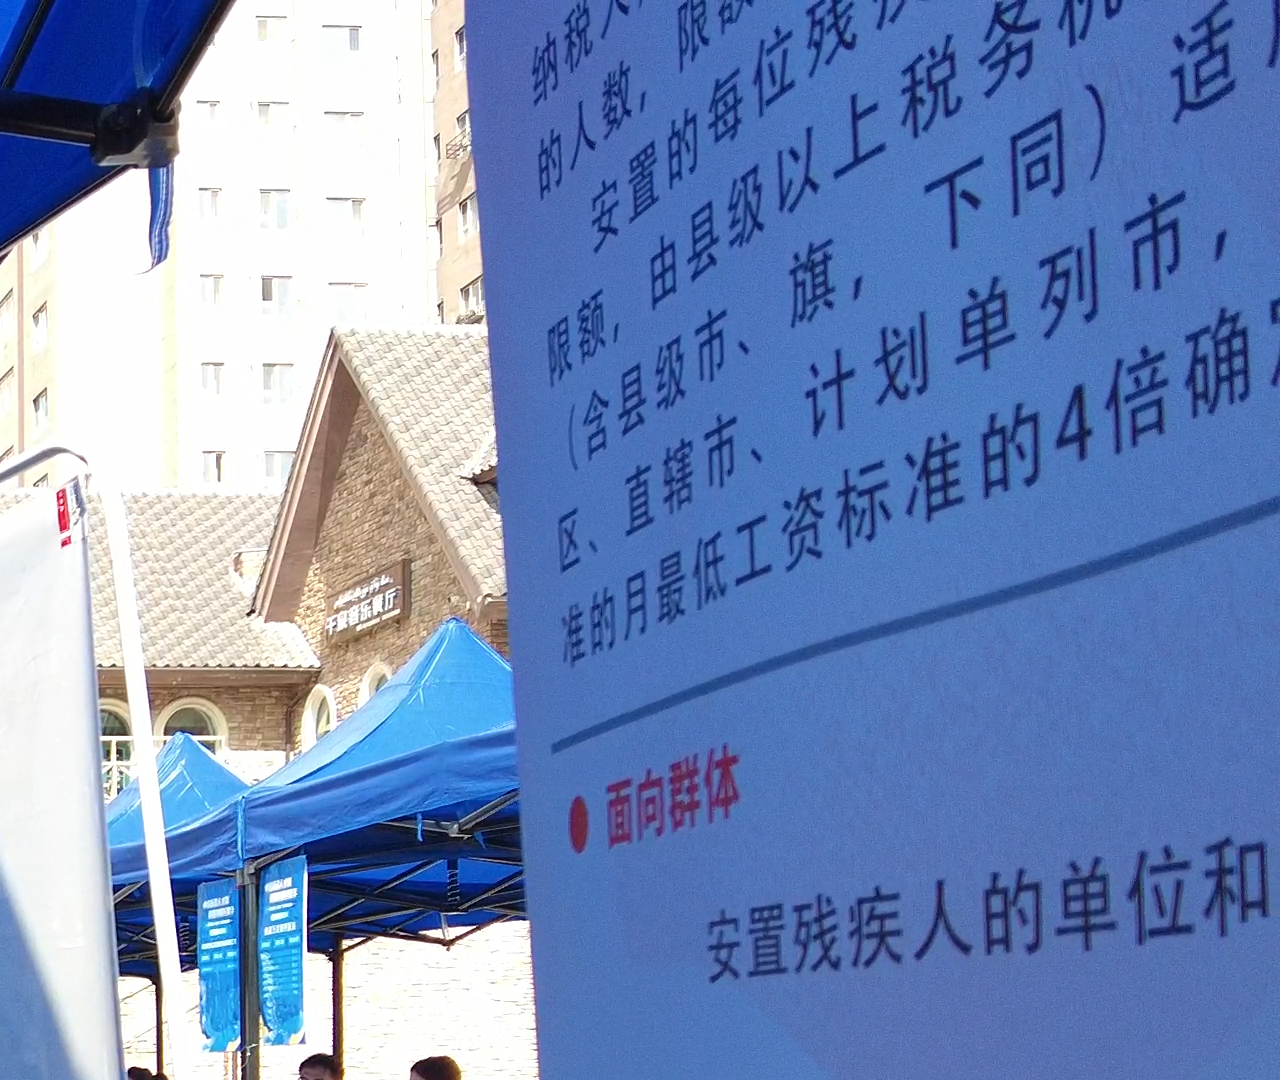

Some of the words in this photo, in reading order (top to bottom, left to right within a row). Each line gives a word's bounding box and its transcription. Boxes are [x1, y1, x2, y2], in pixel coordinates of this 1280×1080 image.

[567, 0, 1280, 471] （含县级市、旗，下同）适
[562, 298, 1280, 669] 准的月最低工资标准的4倍确
[604, 743, 741, 850] 面向群体
[706, 836, 1272, 984] 安置残疾人的单位和
